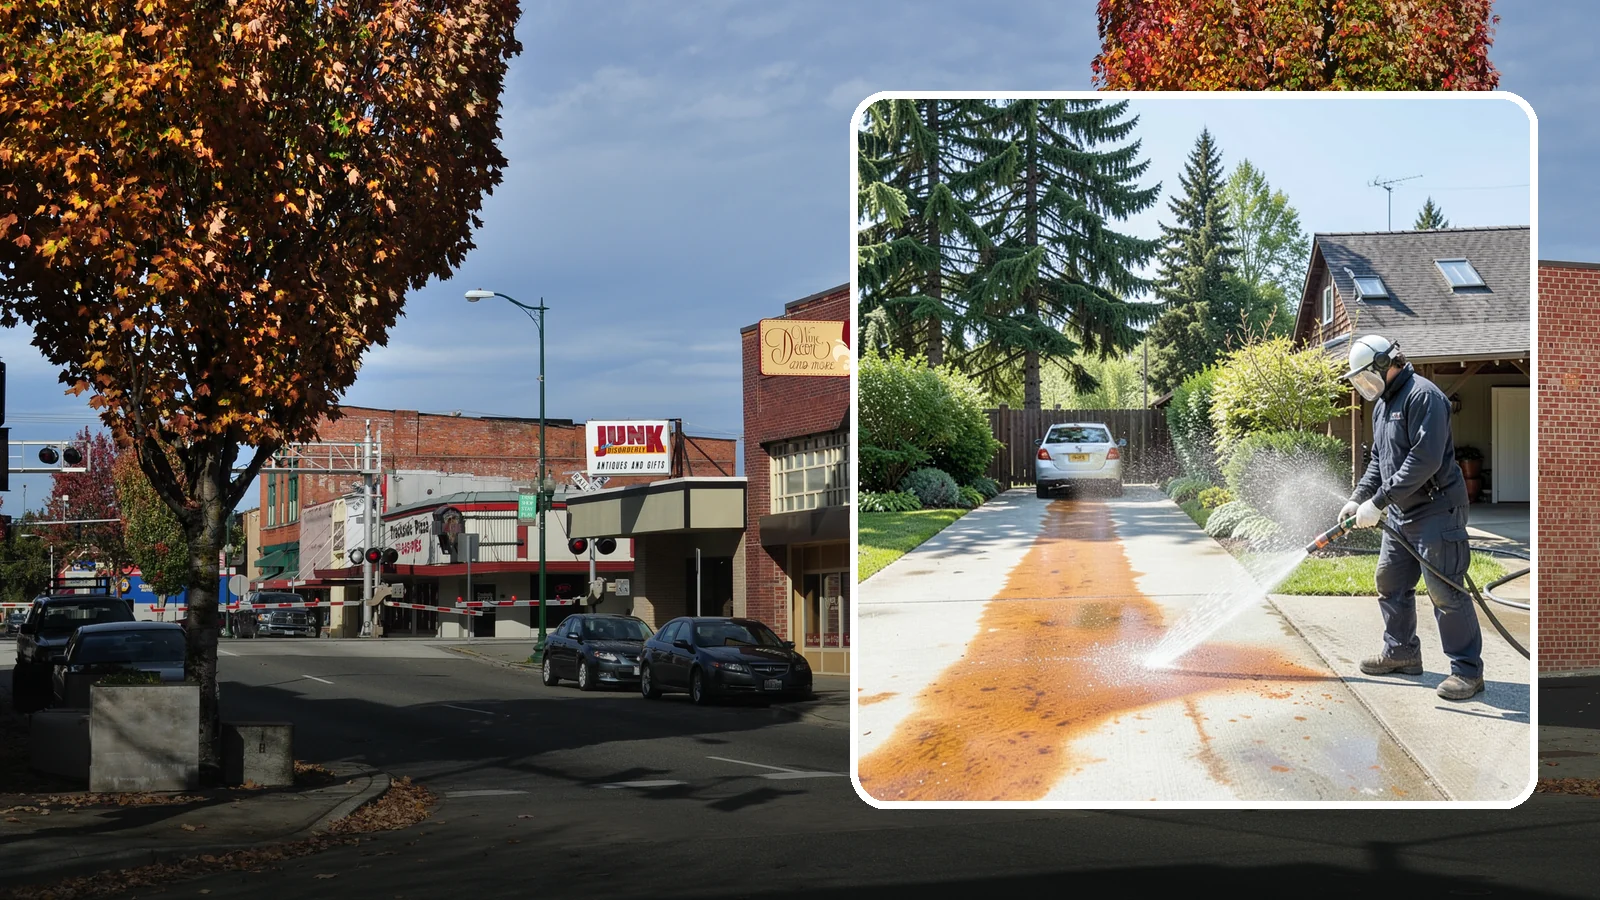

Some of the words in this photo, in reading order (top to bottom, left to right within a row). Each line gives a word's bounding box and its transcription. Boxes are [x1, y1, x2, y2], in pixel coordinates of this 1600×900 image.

[595, 425, 665, 457] JUNK
[608, 446, 646, 454] DISORDERLY
[597, 461, 628, 470] ANTIQUES
[631, 461, 644, 470] AND
[647, 460, 665, 470] GIFTS
[573, 473, 589, 492] RAIL
[414, 520, 429, 534] Pizza
